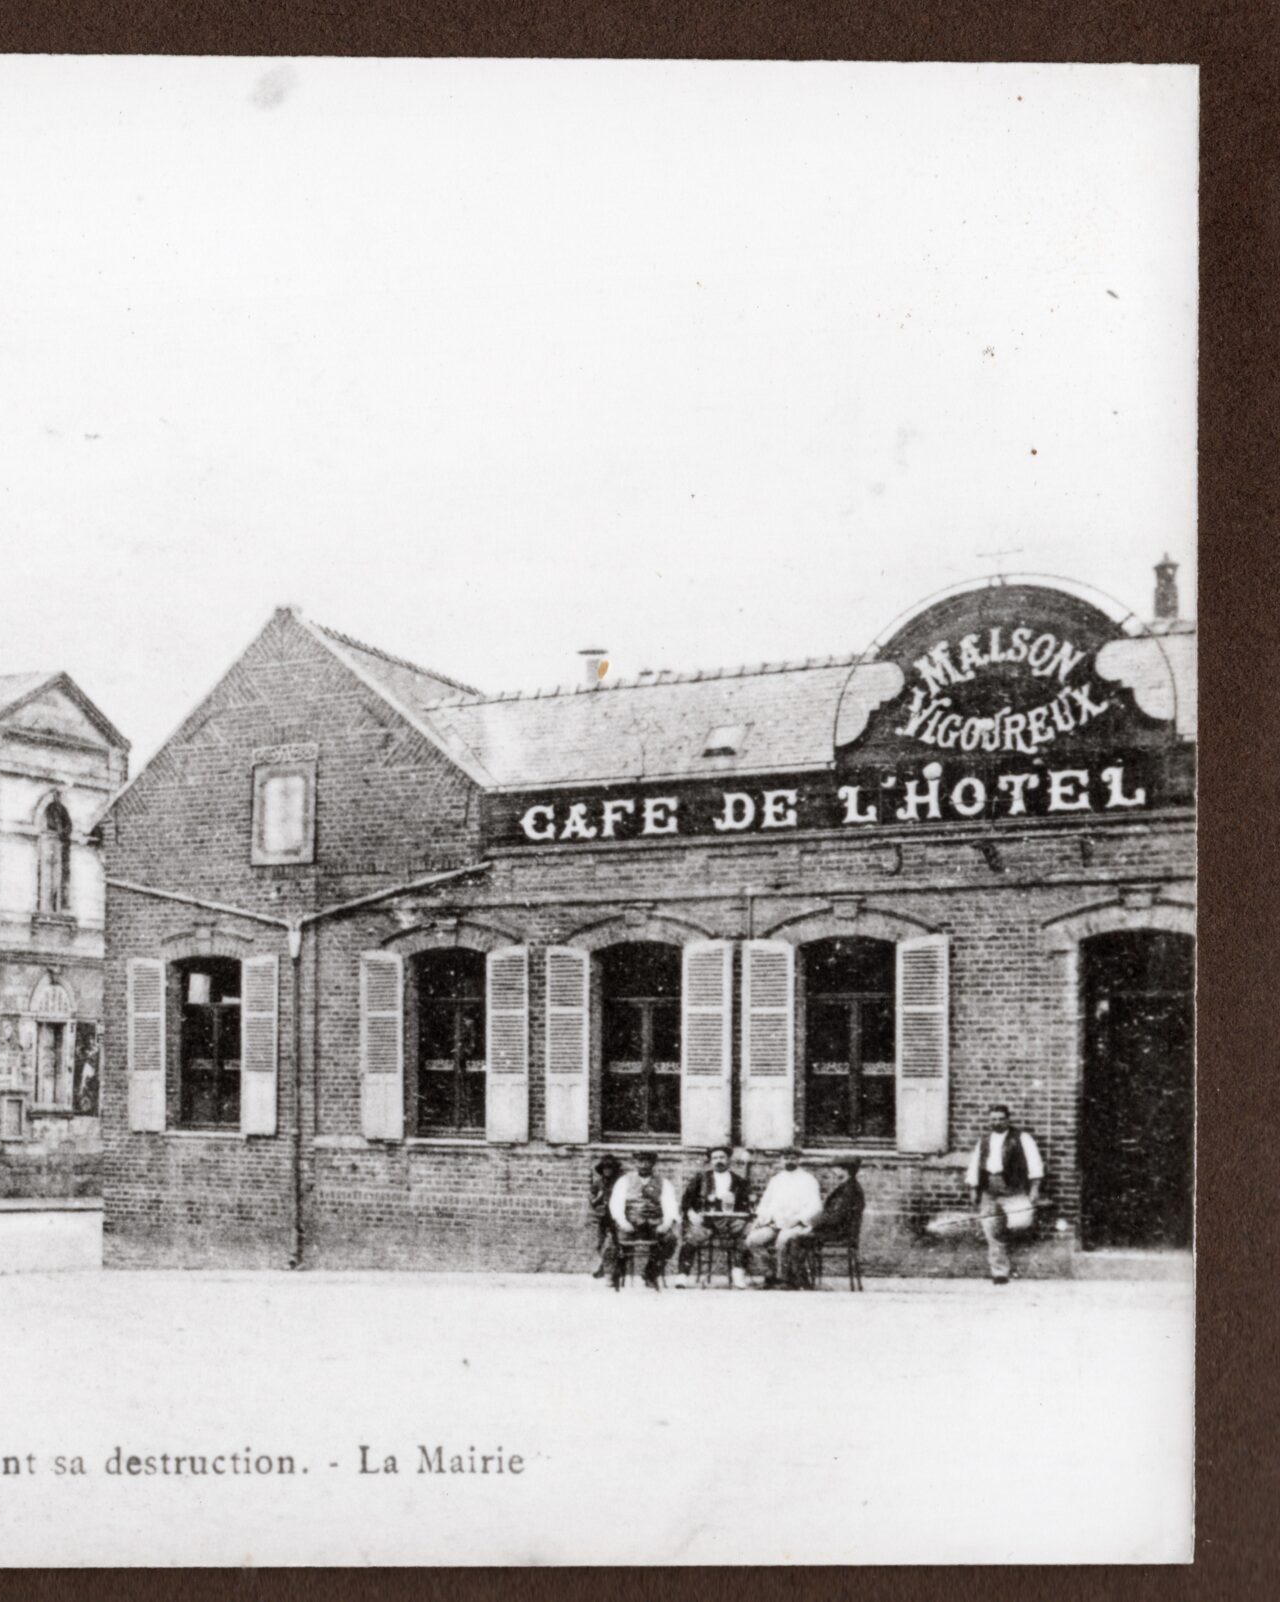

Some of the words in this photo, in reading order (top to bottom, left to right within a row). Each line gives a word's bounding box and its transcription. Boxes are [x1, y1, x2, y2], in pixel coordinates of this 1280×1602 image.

[914, 627, 1086, 698] MAISON
[894, 684, 1109, 755] VIGOUREUX
[520, 796, 679, 840] CAFE
[713, 788, 798, 831] DE
[53, 1455, 86, 1476] sa
[104, 1445, 310, 1476] destruction.
[358, 1445, 400, 1475] La
[417, 1444, 526, 1475] Mairie
